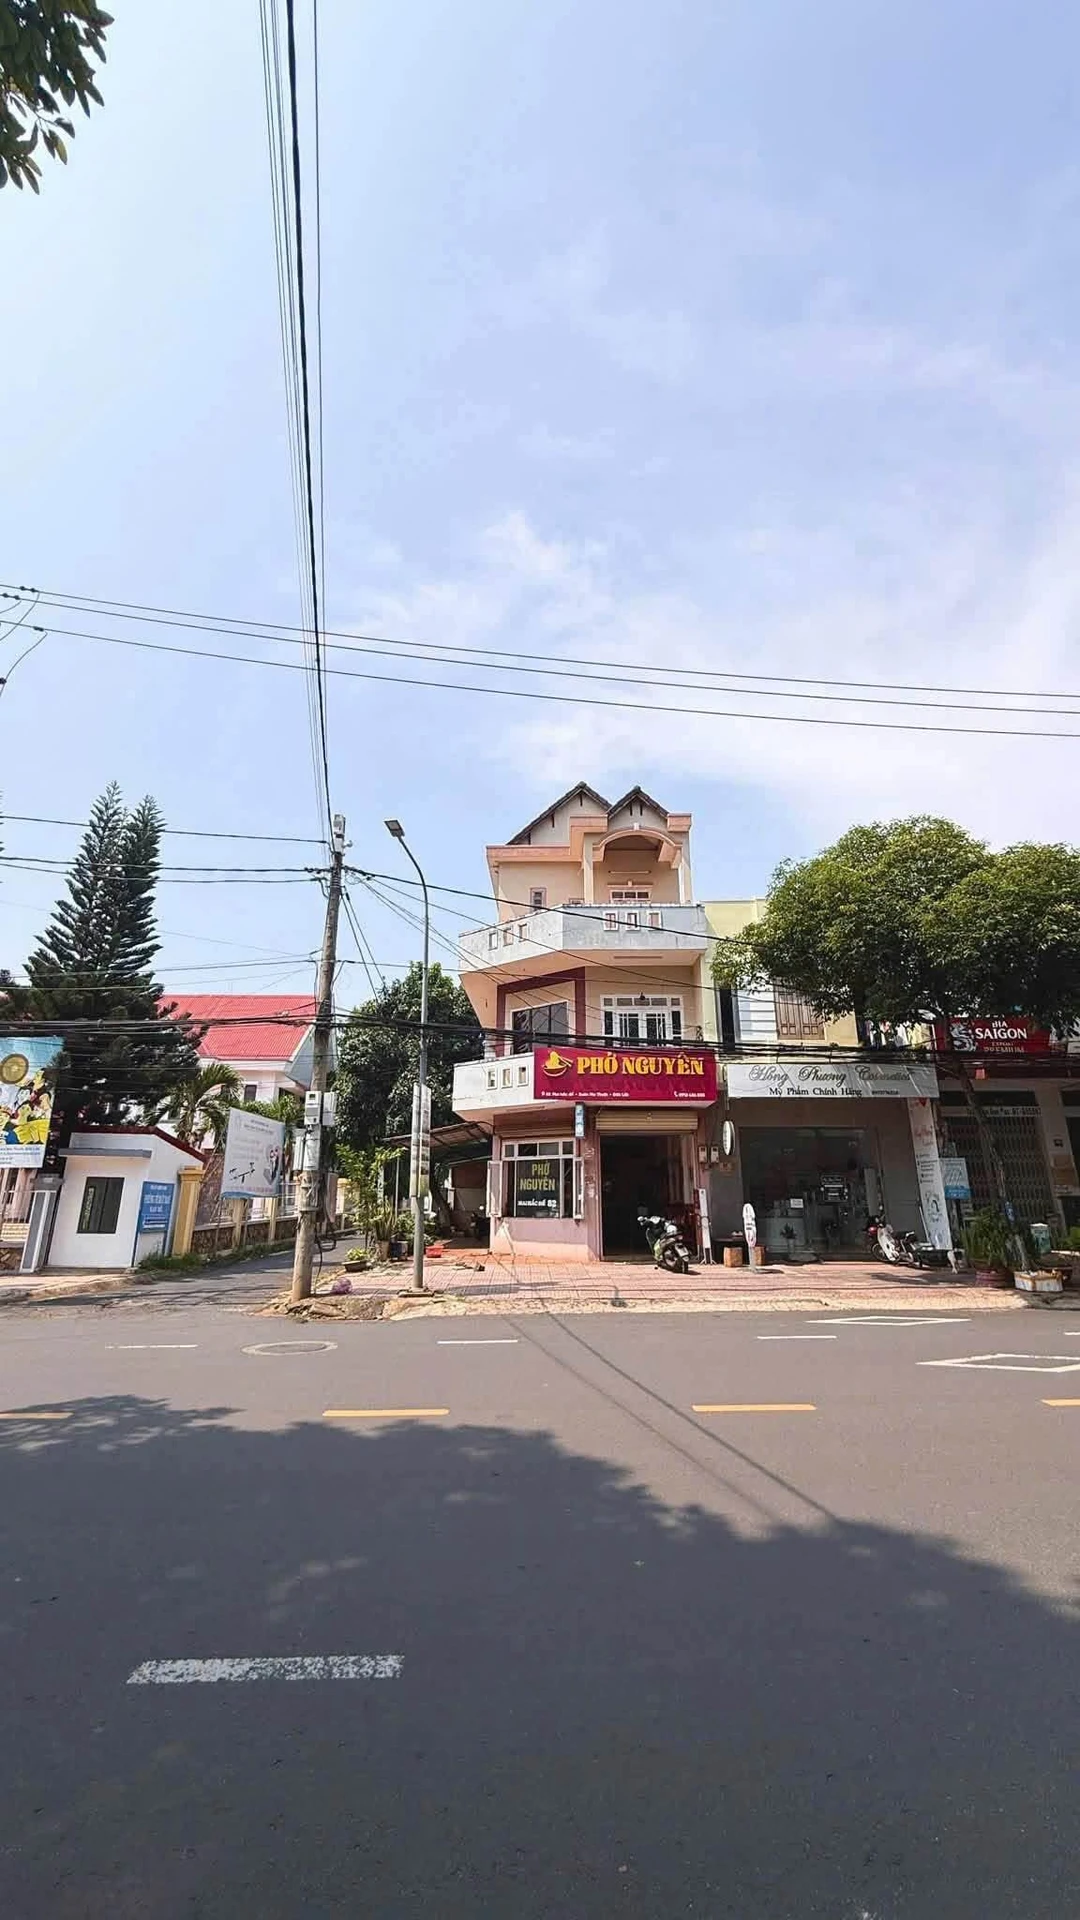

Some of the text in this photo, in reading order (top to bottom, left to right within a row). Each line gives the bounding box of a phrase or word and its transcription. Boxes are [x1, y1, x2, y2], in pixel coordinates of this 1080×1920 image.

[975, 1028, 1028, 1040] SAIGON
[576, 1051, 619, 1075] PHỞ
[520, 1160, 556, 1191] PHỞ NGUYÊN
